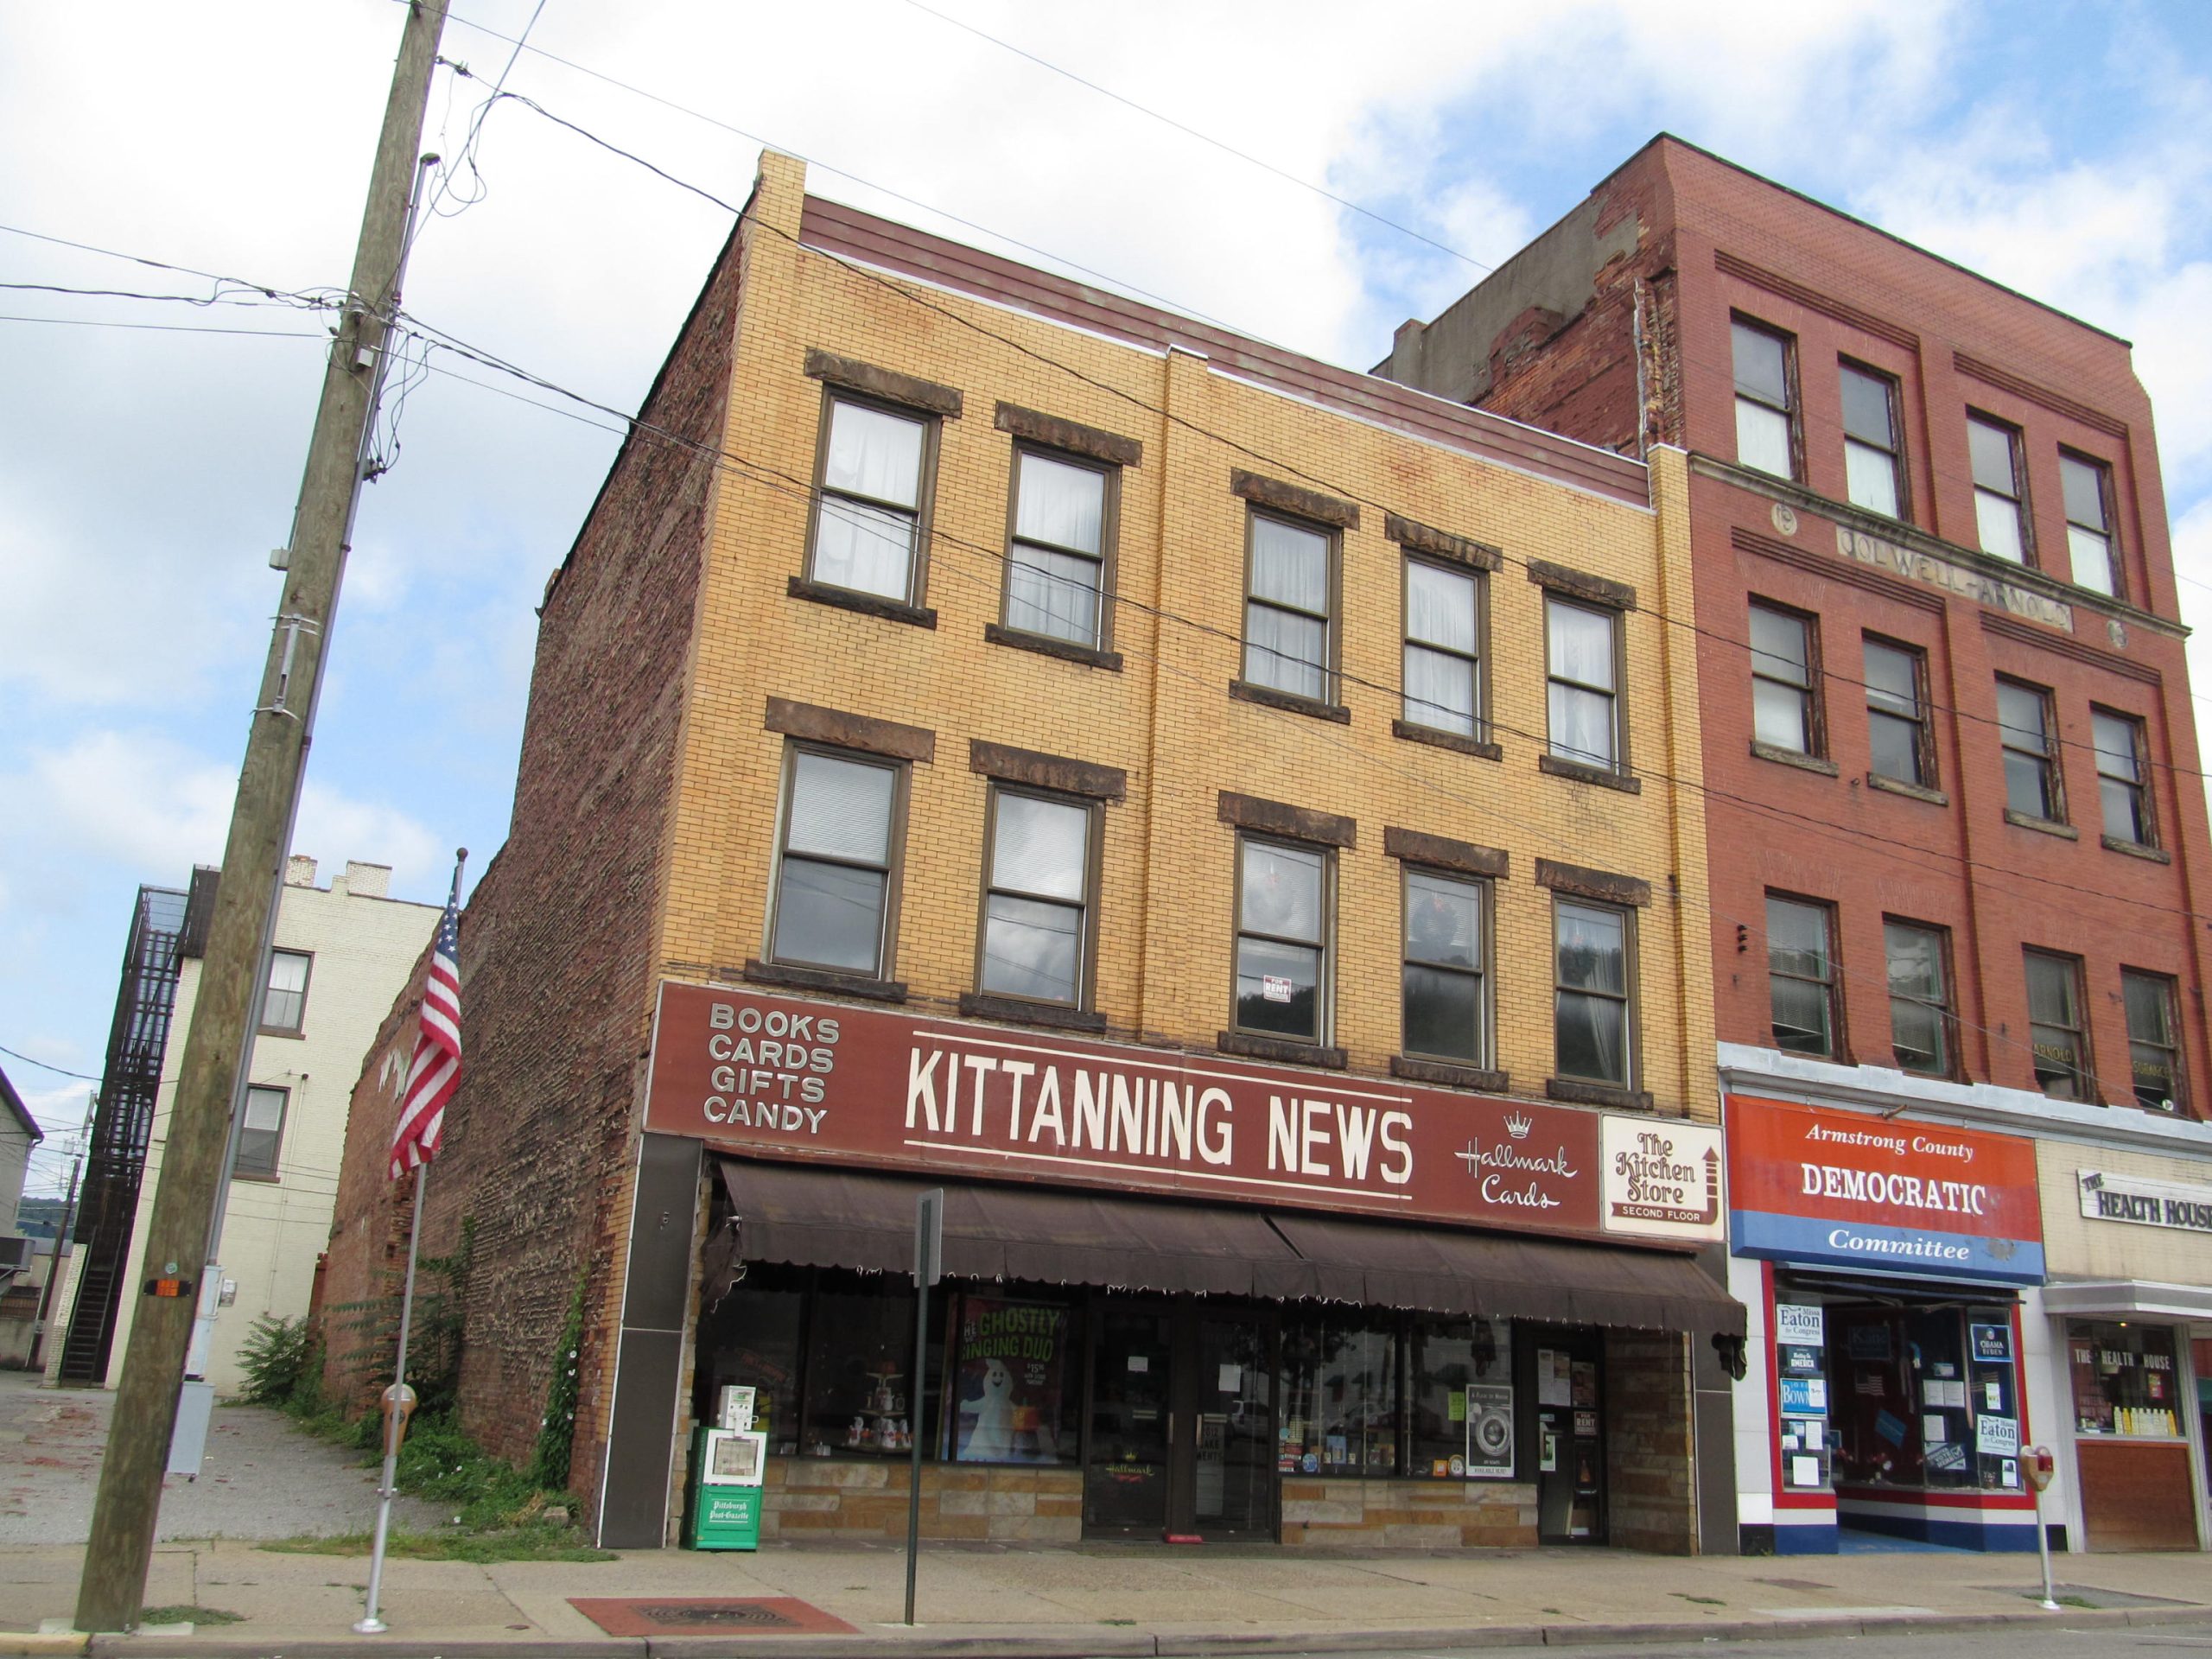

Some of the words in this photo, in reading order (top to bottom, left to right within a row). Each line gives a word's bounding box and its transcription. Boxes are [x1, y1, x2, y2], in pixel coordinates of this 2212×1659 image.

[1265, 982, 1288, 994] RENT
[709, 1002, 840, 1045] BOOKS
[709, 1034, 835, 1074] CARDS
[2033, 1043, 2074, 1062] ARNOLD
[710, 1065, 826, 1103] GIFTS
[702, 1096, 829, 1134] CANDY
[905, 1047, 1233, 1166] KITTANNING
[1268, 1095, 1413, 1185] NEWS
[1453, 1136, 1579, 1179] Hallmark
[1637, 1132, 1674, 1158] The
[1805, 1123, 1907, 1156] Armstrong
[1912, 1135, 1974, 1163] County
[1615, 1151, 1697, 1184] Kitchen
[1480, 1173, 1561, 1209] Cards
[1626, 1176, 1685, 1205] Store
[1800, 1162, 1986, 1216] DEMOCRATIC
[2082, 1172, 2106, 1193] THE
[1622, 1205, 1664, 1219] SECOND
[1667, 1210, 1701, 1223] FLOOR
[2097, 1190, 2161, 1224] HEALTH
[1827, 1228, 1971, 1261] Committee
[980, 1307, 1060, 1338] GHOSTLY
[1780, 1308, 1821, 1328] Eaton
[1022, 1337, 1055, 1363] DUO
[1980, 1340, 2005, 1350] OBAMA
[2075, 1348, 2092, 1364] THE
[2101, 1350, 2134, 1368] HEALTH
[2142, 1353, 2171, 1370] HOUSE
[1790, 1359, 1815, 1369] AMERICA
[1576, 1418, 1596, 1427] RENT
[1980, 1419, 2015, 1440] Eaton
[713, 1500, 747, 1511] Pittsburgh
